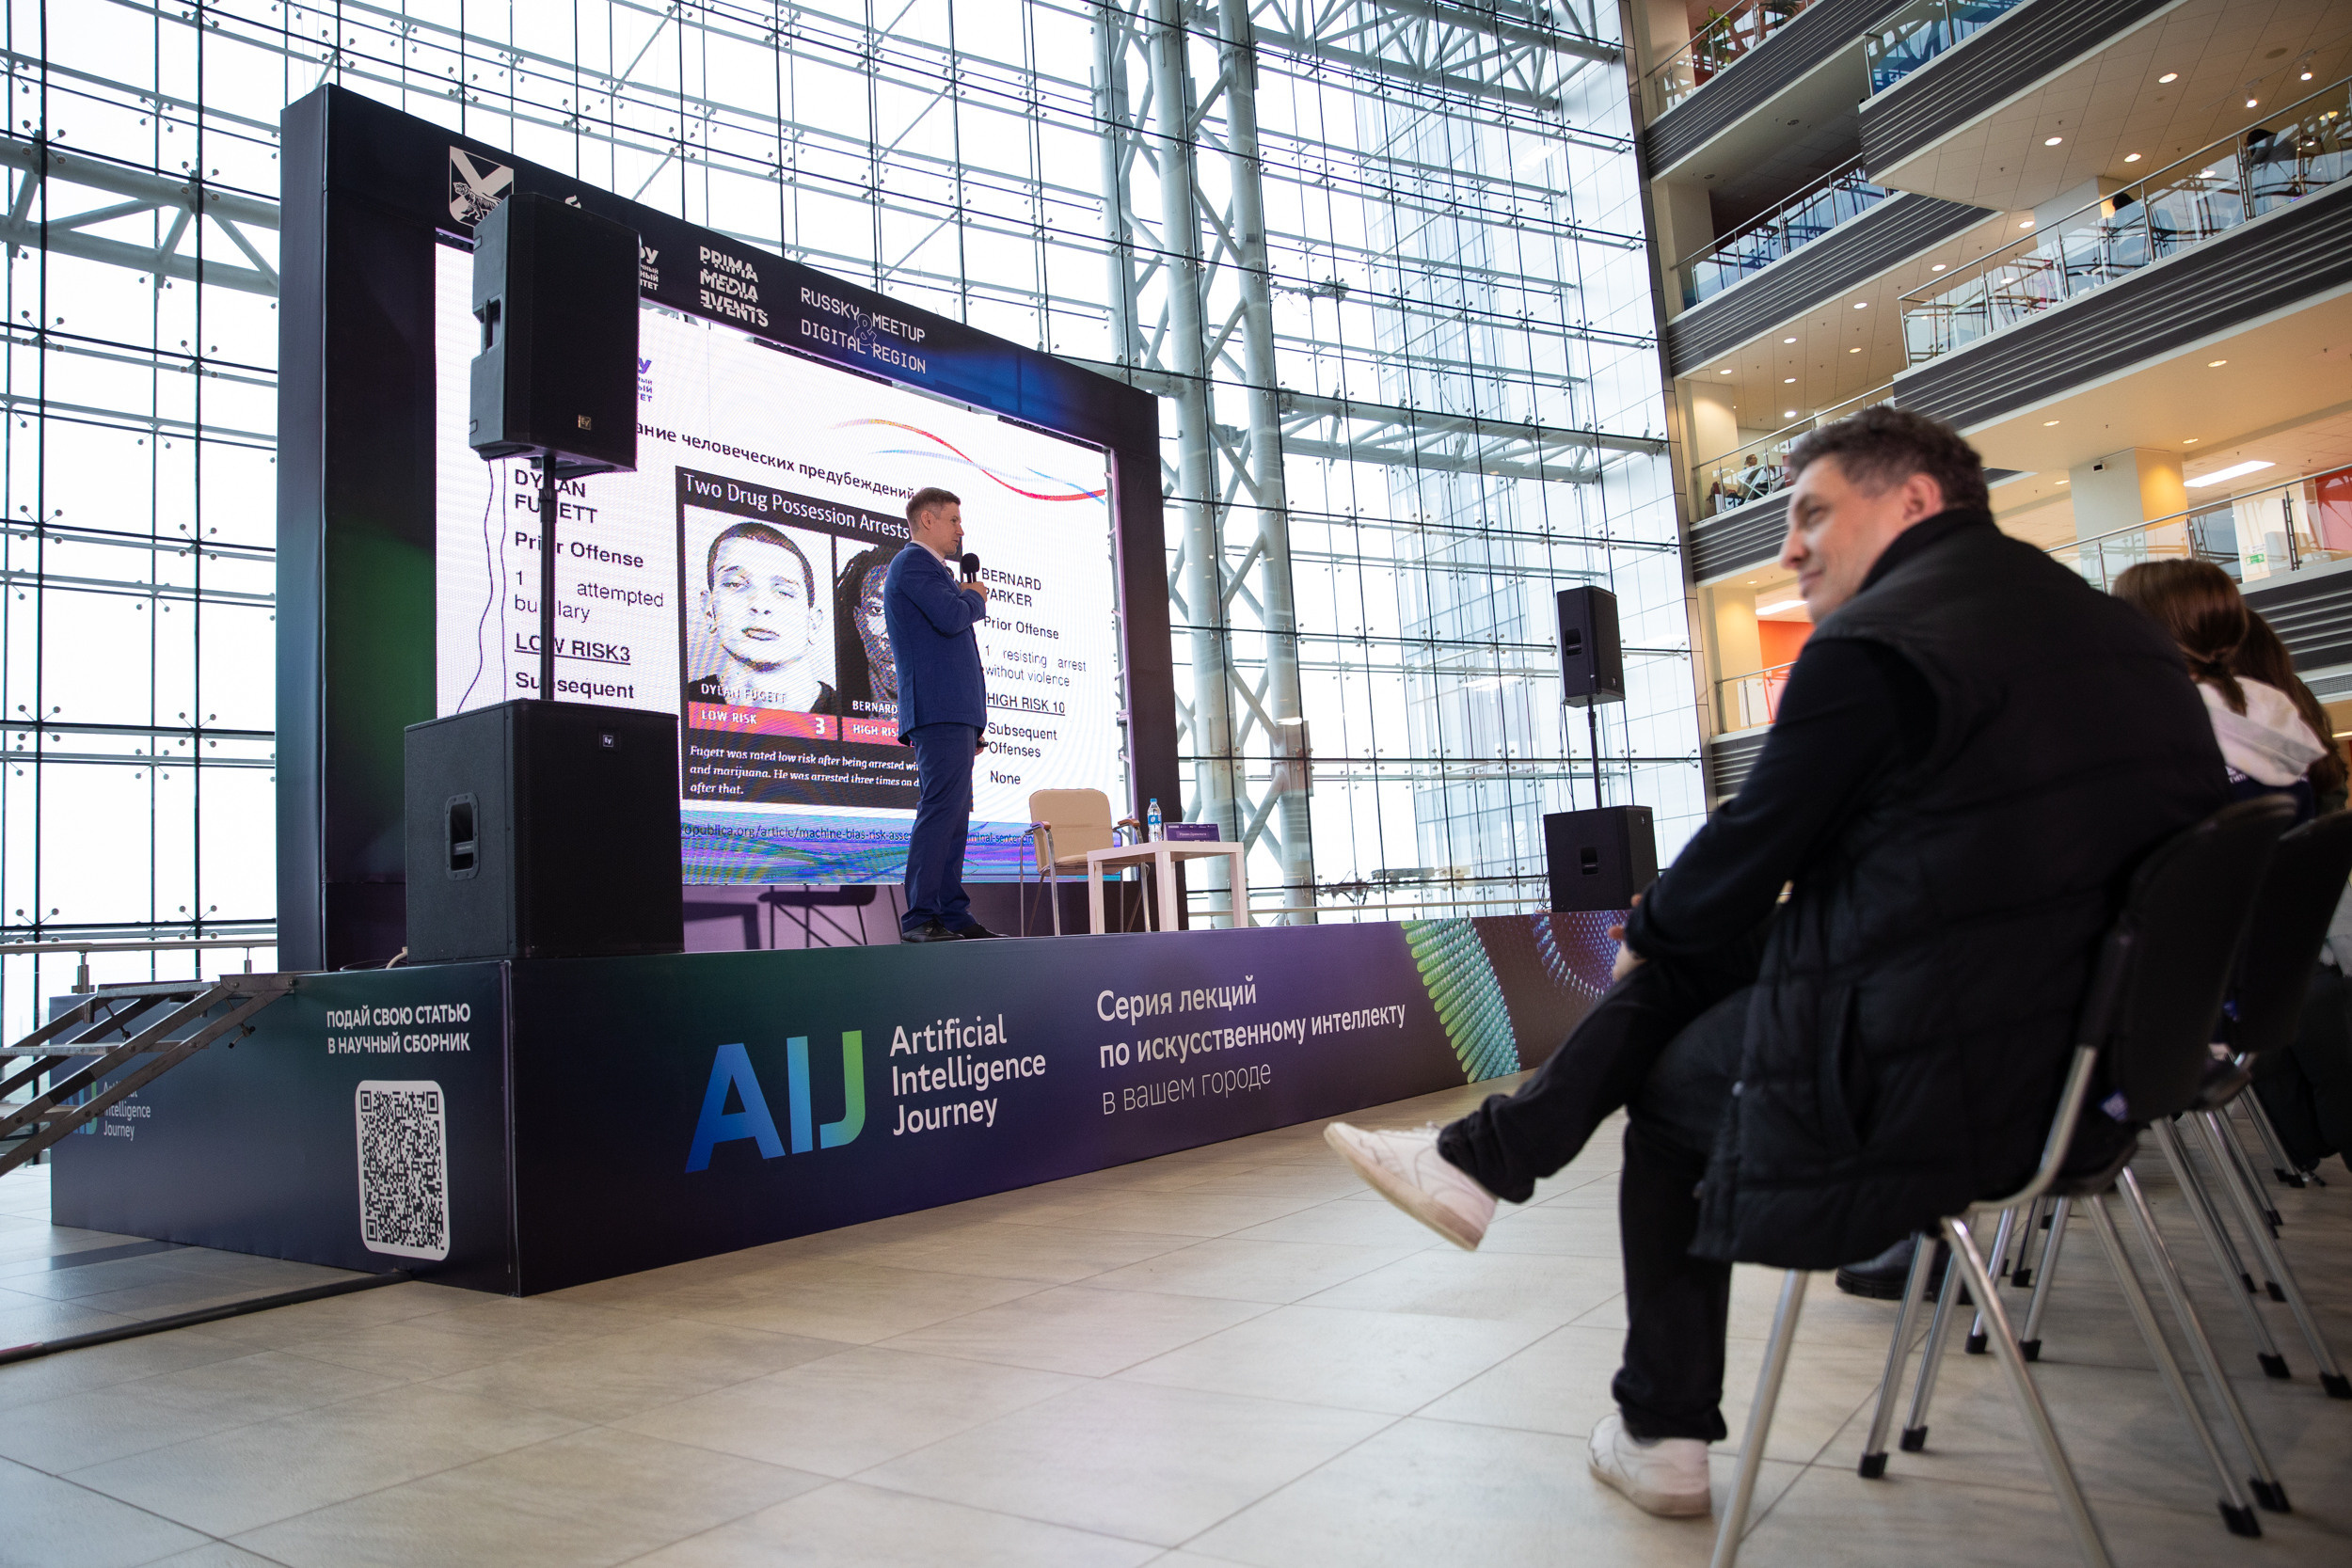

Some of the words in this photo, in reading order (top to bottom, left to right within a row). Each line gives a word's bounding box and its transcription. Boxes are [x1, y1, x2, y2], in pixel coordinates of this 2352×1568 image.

[700, 245, 759, 282] PRIMA
[700, 268, 759, 303] MEDIA
[700, 289, 769, 327] EVENTS
[802, 287, 861, 319] RUSSKY
[872, 312, 926, 343] MEETUP
[802, 319, 866, 355] DIGITAL
[873, 343, 926, 373] REGION
[682, 434, 794, 471] человеческих
[800, 463, 914, 500] предубеждений
[515, 468, 586, 498] DYAN
[515, 494, 597, 524] FUETT
[684, 473, 723, 499] Two
[727, 483, 768, 512] Drug
[772, 494, 855, 528] Possession
[860, 516, 910, 540] Arrests
[516, 531, 564, 554] Prir
[570, 541, 644, 568] Offense
[516, 570, 522, 585] 1
[577, 582, 664, 608] attempted
[981, 567, 1041, 591] BERNARD
[515, 594, 591, 624] bulary
[984, 615, 1011, 631] Prior
[1016, 621, 1059, 640] Offense
[572, 640, 631, 662] RISK3
[985, 644, 990, 657] 1
[1003, 649, 1047, 669] resisting
[1057, 658, 1087, 672] arrest
[516, 672, 634, 699] Susequent
[985, 664, 1025, 681] without
[1027, 671, 1071, 687] violence
[701, 710, 727, 721] LOW
[732, 712, 757, 724] RISK
[852, 700, 898, 715] BERNARD
[987, 692, 1018, 708] HIGH
[1022, 697, 1049, 712] RISK
[1053, 701, 1065, 714] 10
[815, 717, 825, 735] 3
[853, 724, 878, 736] HIGH
[988, 721, 1057, 742] Subsequent
[726, 750, 748, 759] was
[749, 751, 776, 761] rated
[778, 752, 797, 763] low
[798, 752, 816, 765] risk
[818, 754, 840, 767] after
[842, 755, 867, 770] being
[868, 760, 904, 771] arrested
[989, 741, 1041, 758] Offenses
[690, 764, 711, 775] and
[713, 766, 771, 779] marijuana.
[773, 768, 788, 779] He
[811, 772, 850, 784] arrested
[850, 773, 874, 784] three
[875, 775, 900, 786] times
[690, 782, 717, 795] after
[718, 784, 744, 795] that.
[990, 770, 1021, 784] None
[1097, 990, 1173, 1026] Серия
[1179, 974, 1257, 1021] лекций
[326, 1005, 371, 1030] ПОДАЙ
[373, 1006, 413, 1026] СВОЮ
[415, 1003, 470, 1024] СТАТЬЮ
[327, 1037, 336, 1053] В
[339, 1031, 400, 1053] НАУЧНЫЙ
[404, 1032, 470, 1053] СБОРНИК
[889, 1013, 1008, 1057] Artificial
[1100, 1041, 1130, 1069] по
[1137, 1017, 1306, 1064] искусственному
[1311, 1004, 1406, 1036] интеллекту
[892, 1051, 1046, 1097] Intelligence
[685, 1030, 866, 1174] AIJ
[1103, 1091, 1116, 1116] в
[1123, 1076, 1196, 1112] вашем
[1201, 1063, 1271, 1099] городе
[103, 1120, 135, 1141] Journey
[893, 1098, 998, 1136] Journey
